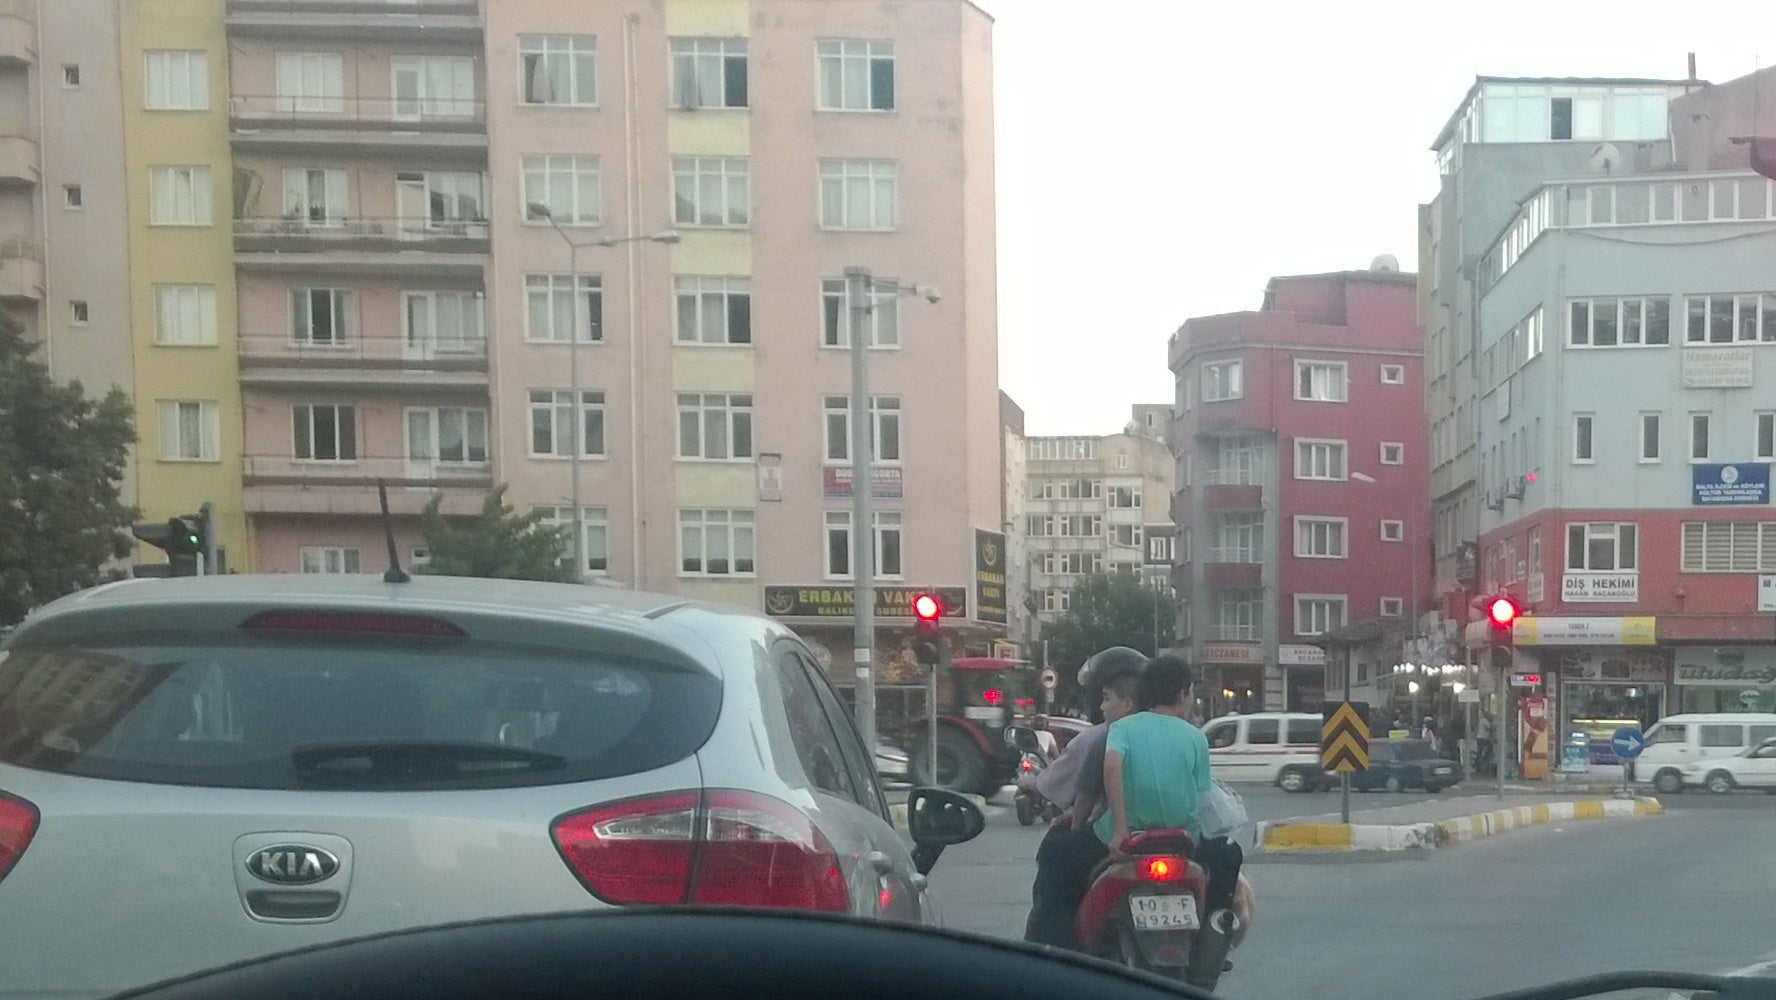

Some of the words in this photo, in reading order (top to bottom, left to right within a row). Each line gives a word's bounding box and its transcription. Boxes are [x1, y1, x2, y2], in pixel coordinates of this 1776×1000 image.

[1566, 577, 1585, 590] DİŞ
[1593, 577, 1635, 588] HEKİMİ
[261, 852, 324, 876] KIA
